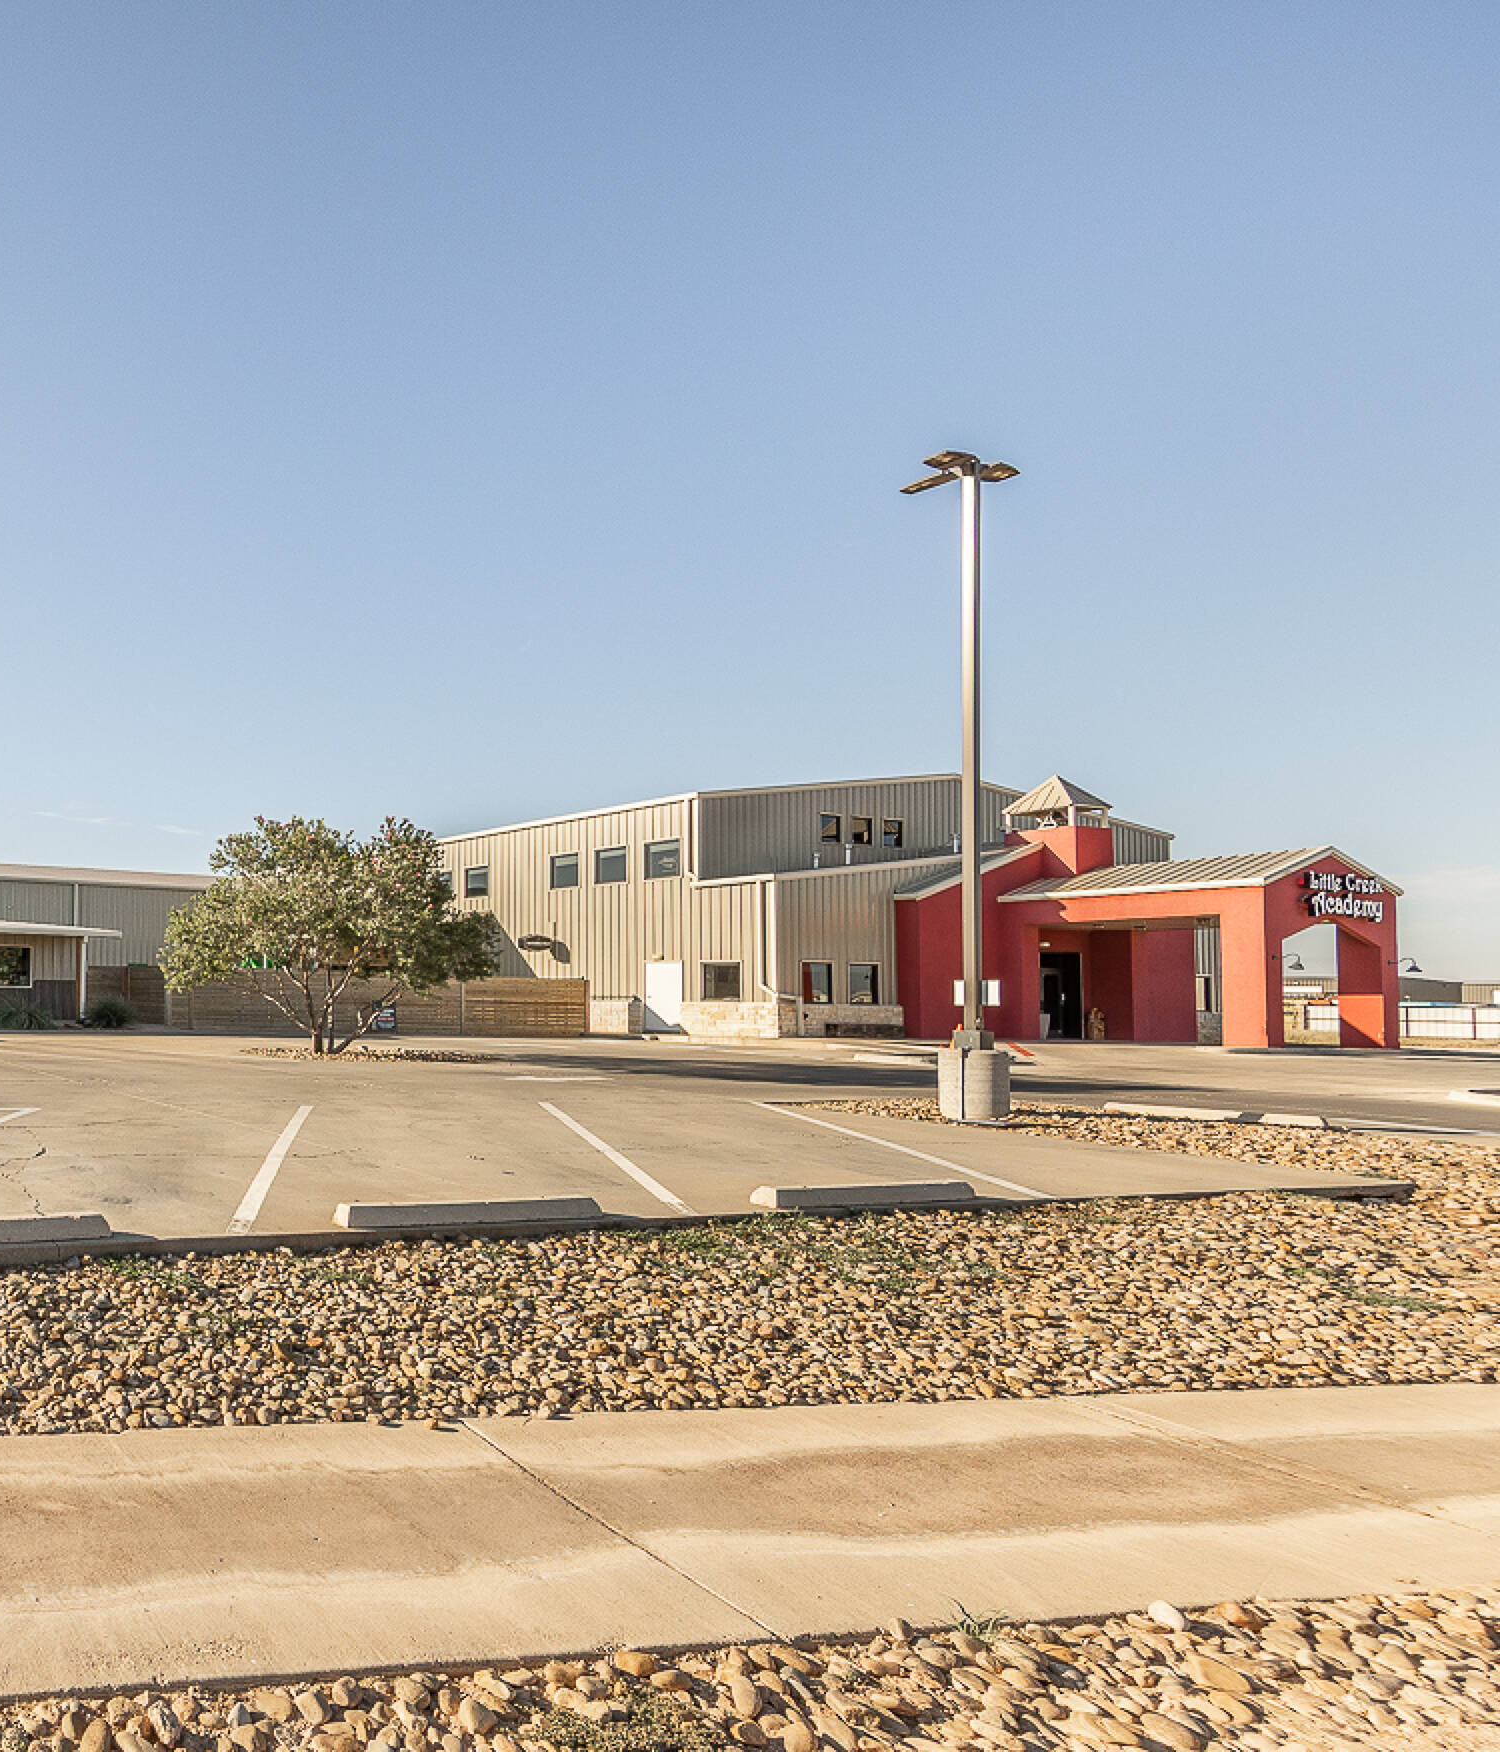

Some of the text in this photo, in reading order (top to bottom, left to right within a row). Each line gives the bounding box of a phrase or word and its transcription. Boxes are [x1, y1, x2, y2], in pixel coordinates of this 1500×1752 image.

[1309, 870, 1384, 893] Little Creek
[1311, 891, 1383, 922] Academy
